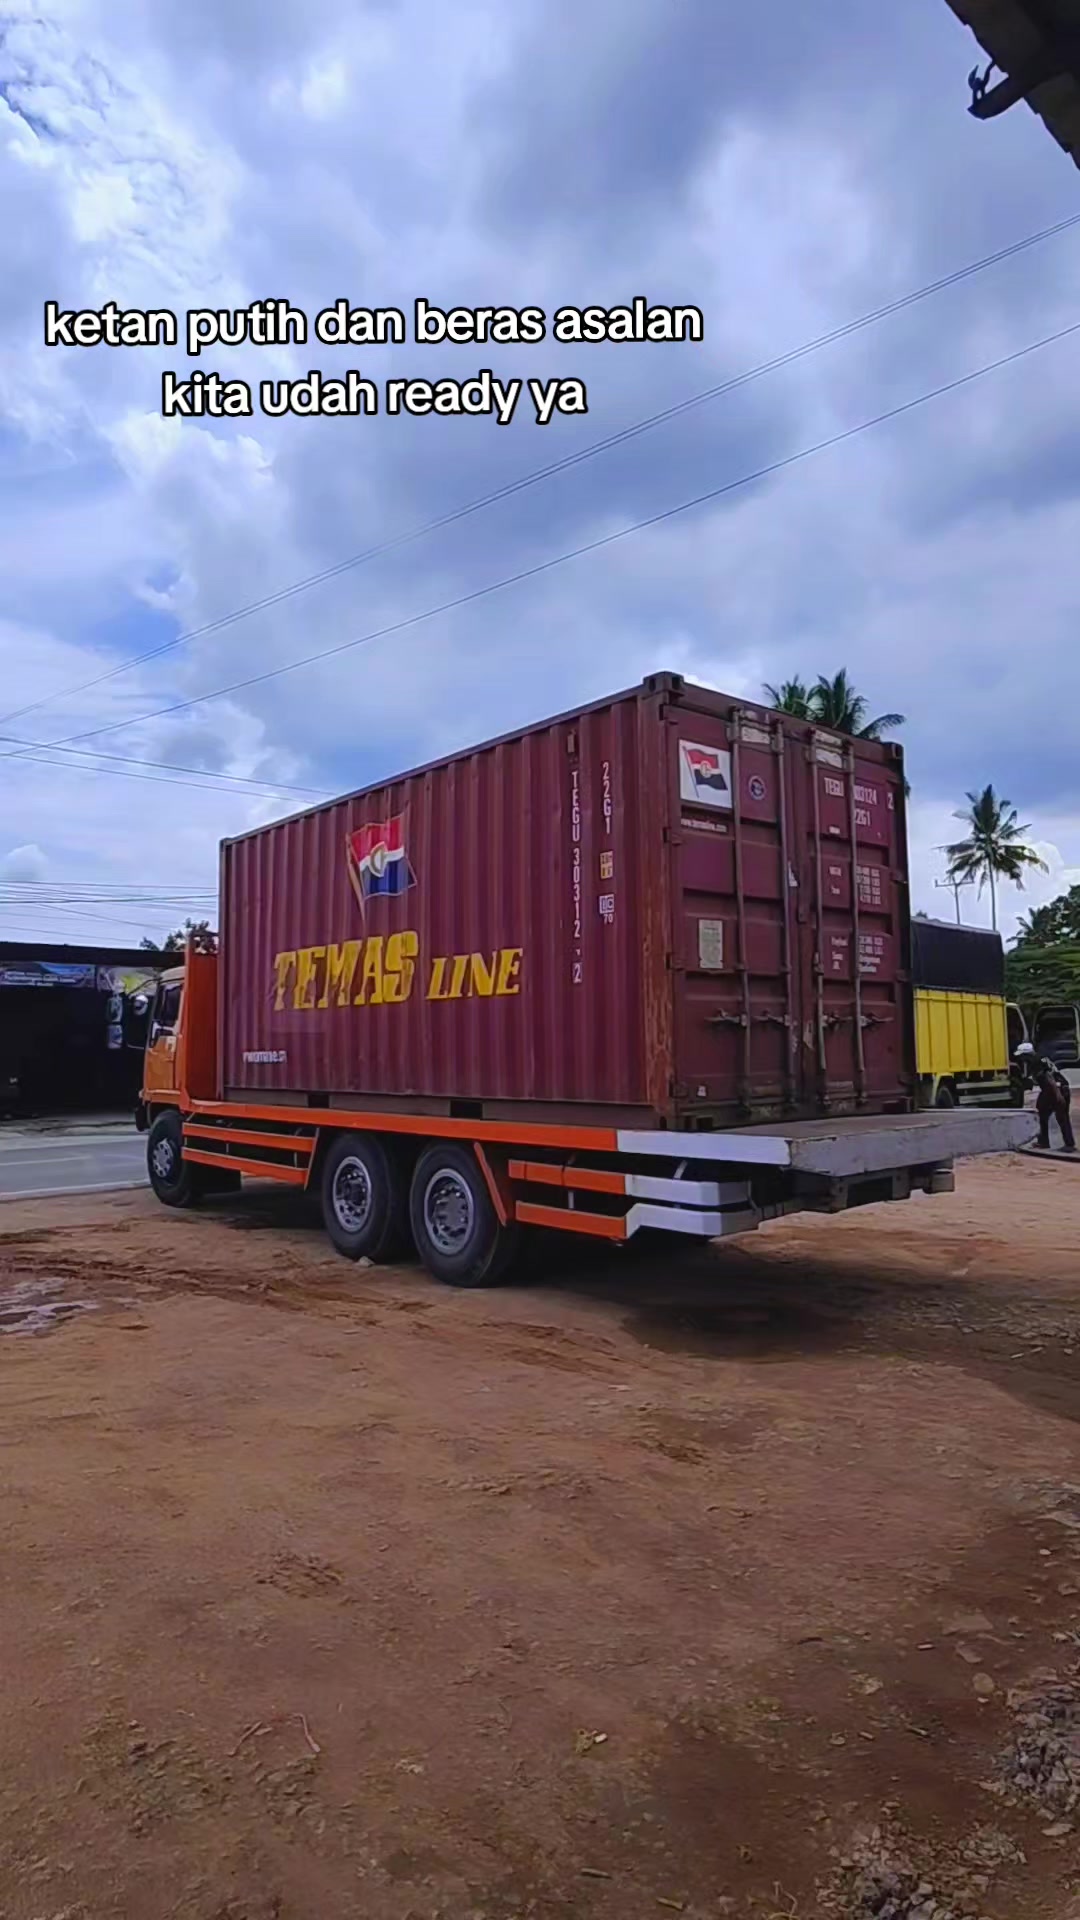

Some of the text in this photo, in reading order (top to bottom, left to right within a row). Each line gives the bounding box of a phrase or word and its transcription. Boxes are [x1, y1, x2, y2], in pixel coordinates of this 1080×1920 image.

[571, 771, 580, 842] TEGU
[602, 762, 612, 834] 22G1
[273, 931, 523, 1011] TEMAS LINE
